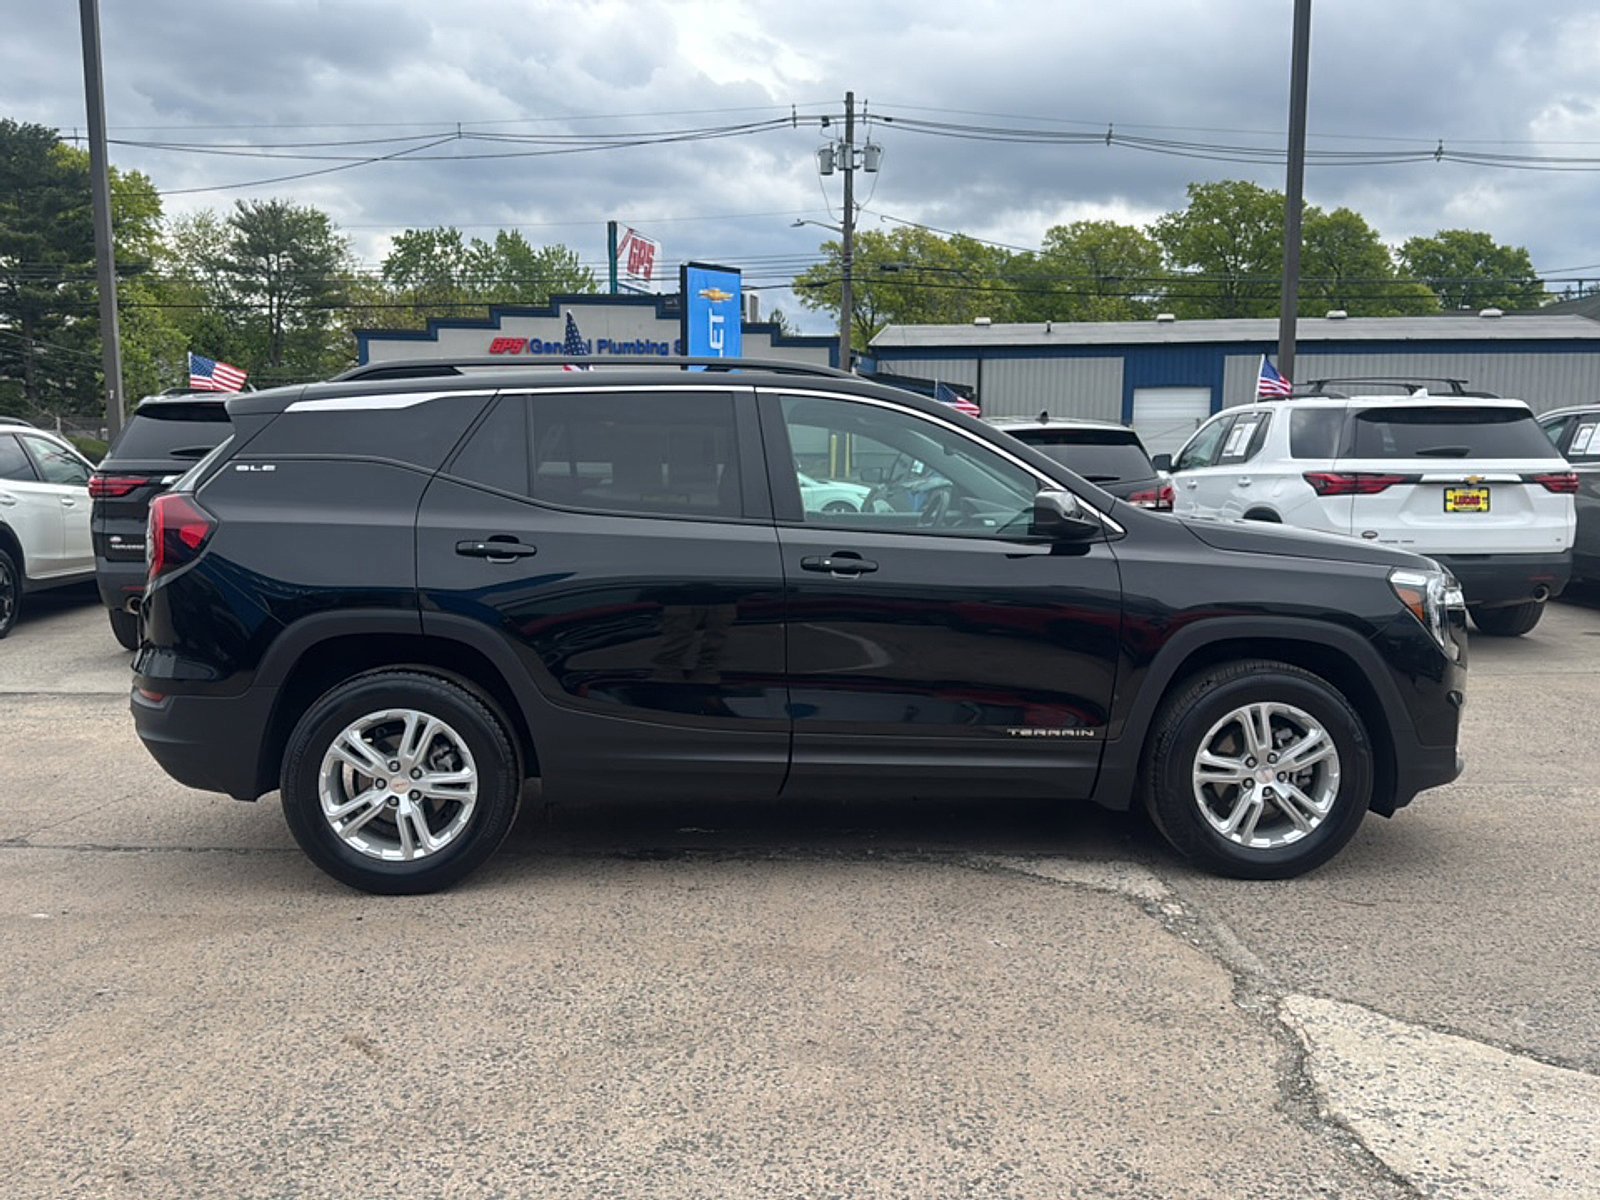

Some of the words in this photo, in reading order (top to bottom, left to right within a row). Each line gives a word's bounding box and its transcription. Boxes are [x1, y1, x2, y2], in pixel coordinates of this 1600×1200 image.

[627, 236, 655, 282] GPS
[489, 337, 527, 354] GPS
[596, 338, 669, 356] Plumbing
[1007, 728, 1095, 737] TERRAIN
